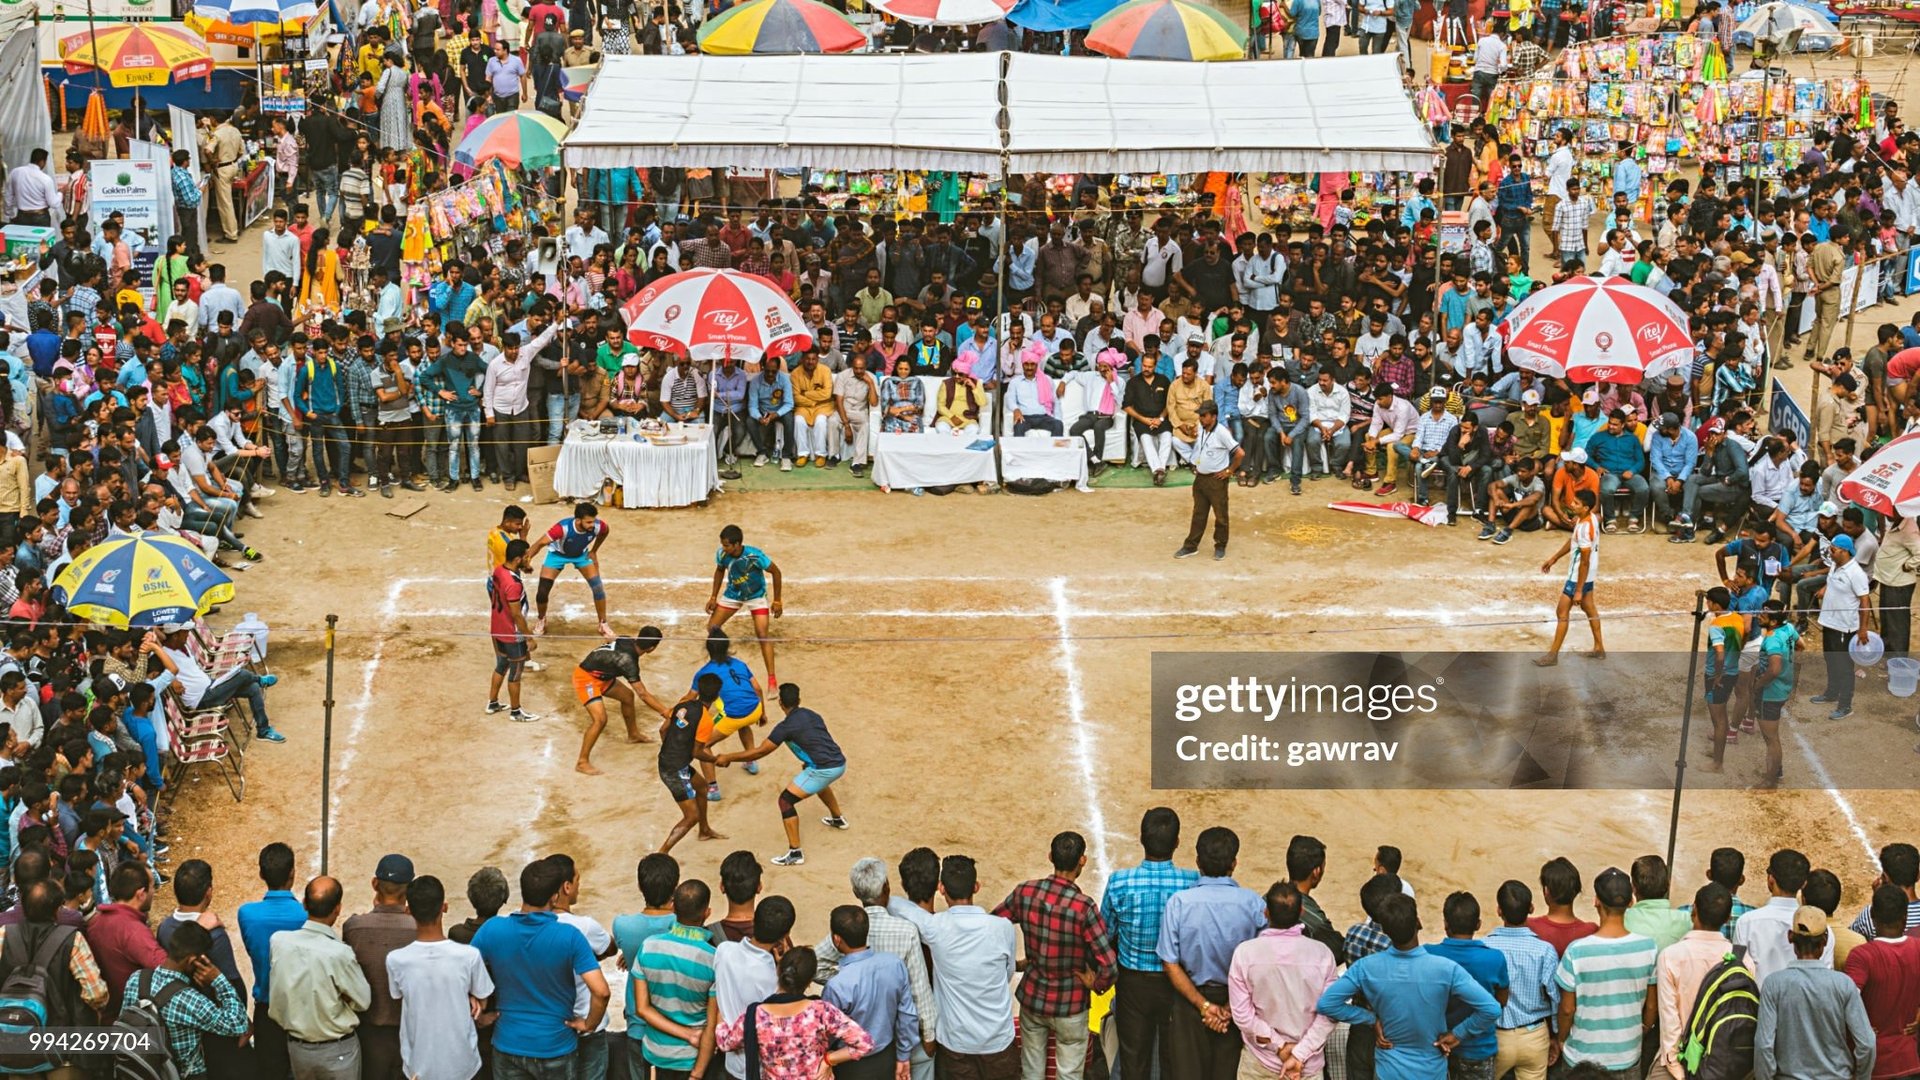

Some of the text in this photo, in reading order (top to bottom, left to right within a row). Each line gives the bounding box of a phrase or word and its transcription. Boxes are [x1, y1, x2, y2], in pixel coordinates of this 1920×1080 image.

[214, 32, 235, 40] 98.3
[127, 186, 147, 194] Palms
[707, 333, 747, 341] Smart Phone
[1527, 340, 1558, 354] Smart Phone
[1663, 342, 1677, 352] Phone
[142, 581, 172, 592] BSNL
[152, 607, 180, 617] LOWEST
[153, 614, 176, 623] TARIFF
